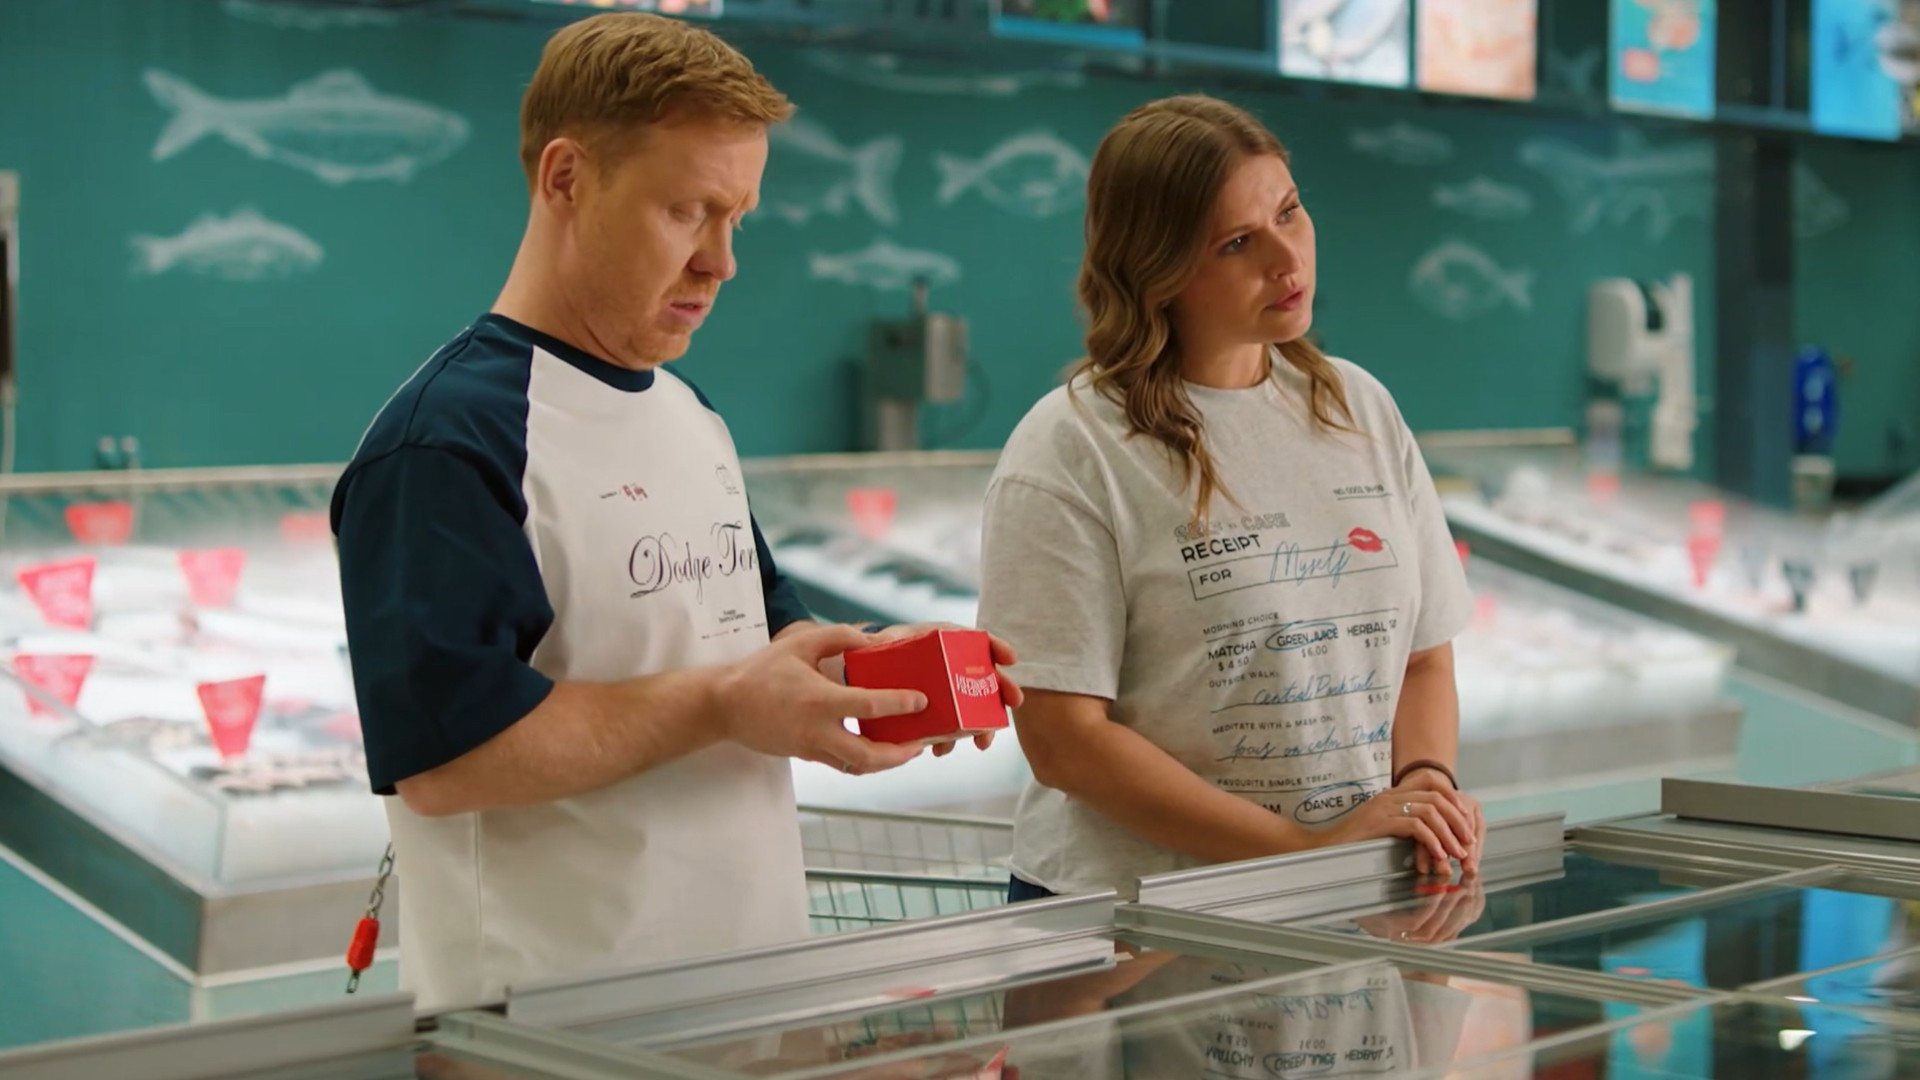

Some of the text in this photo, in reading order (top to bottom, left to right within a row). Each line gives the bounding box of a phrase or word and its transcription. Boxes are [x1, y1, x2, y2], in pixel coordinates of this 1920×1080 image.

[1240, 511, 1292, 531] CARE
[1180, 533, 1262, 563] RECEIPT
[1199, 568, 1232, 585] FOR
[1202, 611, 1280, 635] MORNING CHOICE
[1207, 639, 1258, 661] MATCHA
[1276, 633, 1309, 648] GREEN
[1309, 627, 1340, 643] JUICE
[1346, 621, 1388, 637] HERBAL
[1211, 721, 1255, 735] MEDITATE
[1258, 720, 1282, 731] WITH
[1216, 778, 1265, 788] FAVOURITE
[1268, 777, 1302, 788] SIMPLE
[1303, 796, 1344, 813] DANCE
